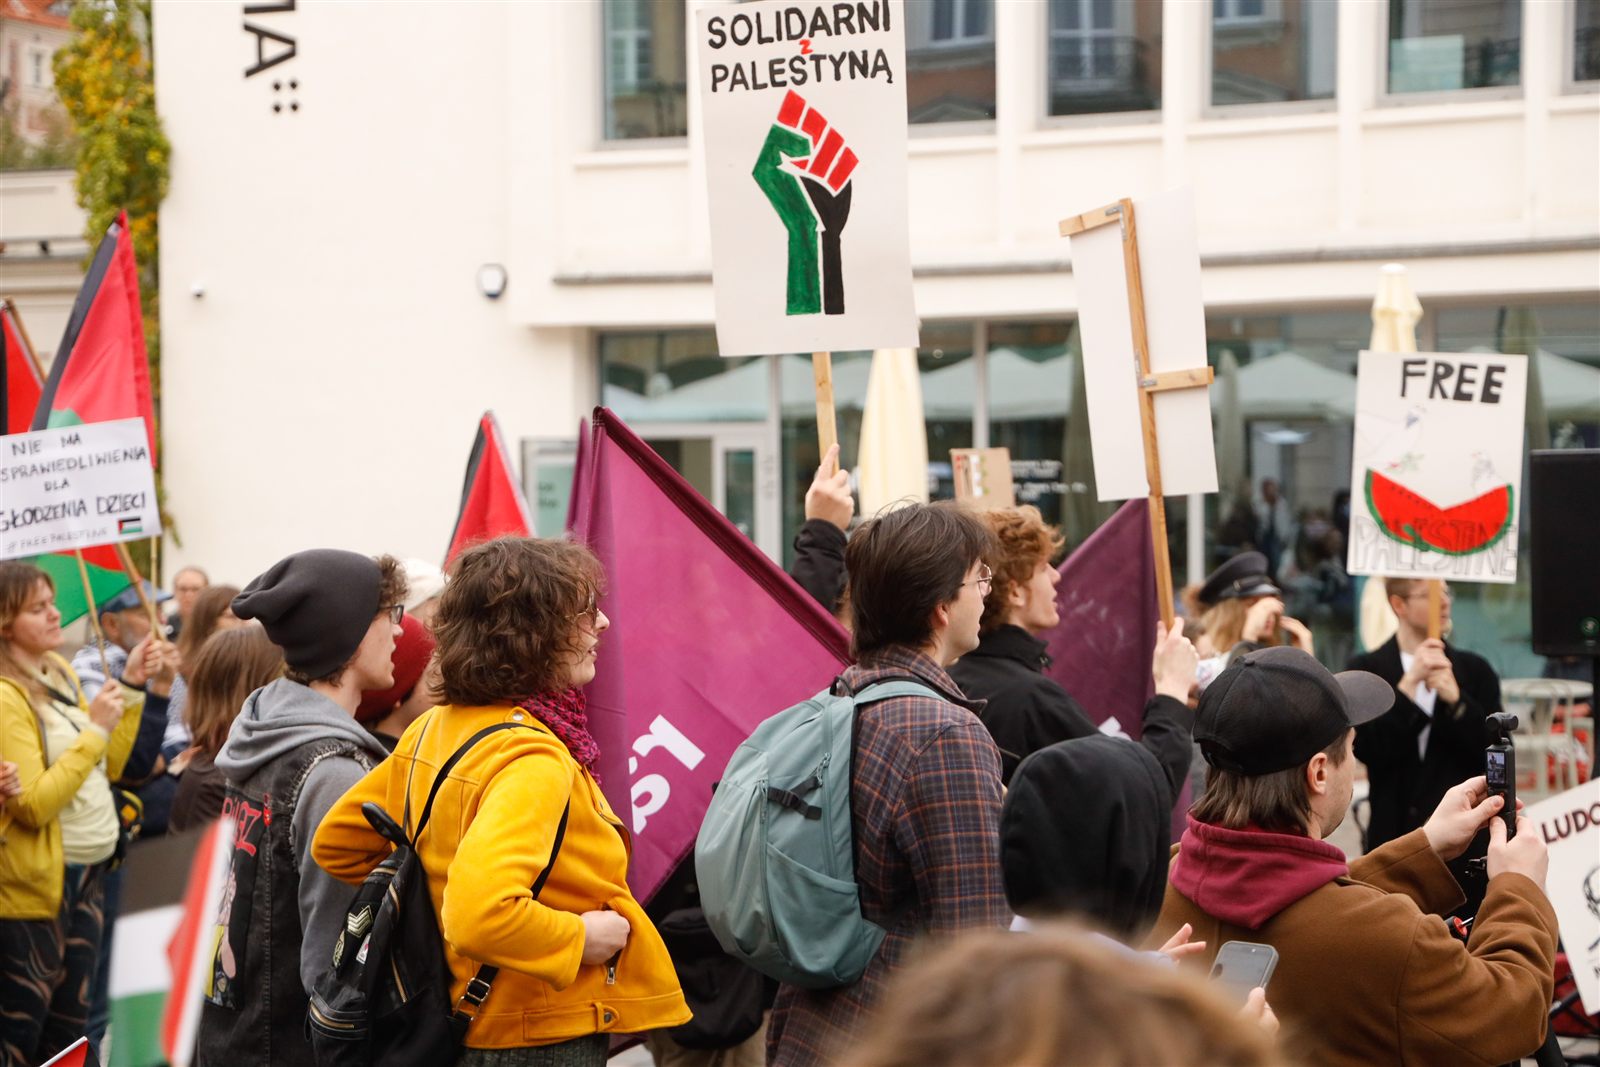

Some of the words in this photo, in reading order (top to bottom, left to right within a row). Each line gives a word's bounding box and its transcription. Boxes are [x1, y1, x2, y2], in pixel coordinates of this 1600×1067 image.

[708, 0, 891, 49] SOLIDARNI
[711, 49, 893, 93] PALESTYNĄ
[1400, 359, 1506, 404] FREE
[12, 440, 42, 456] NIE
[60, 432, 81, 448] MA
[44, 478, 70, 492] DLA
[96, 490, 146, 515] DZIECI
